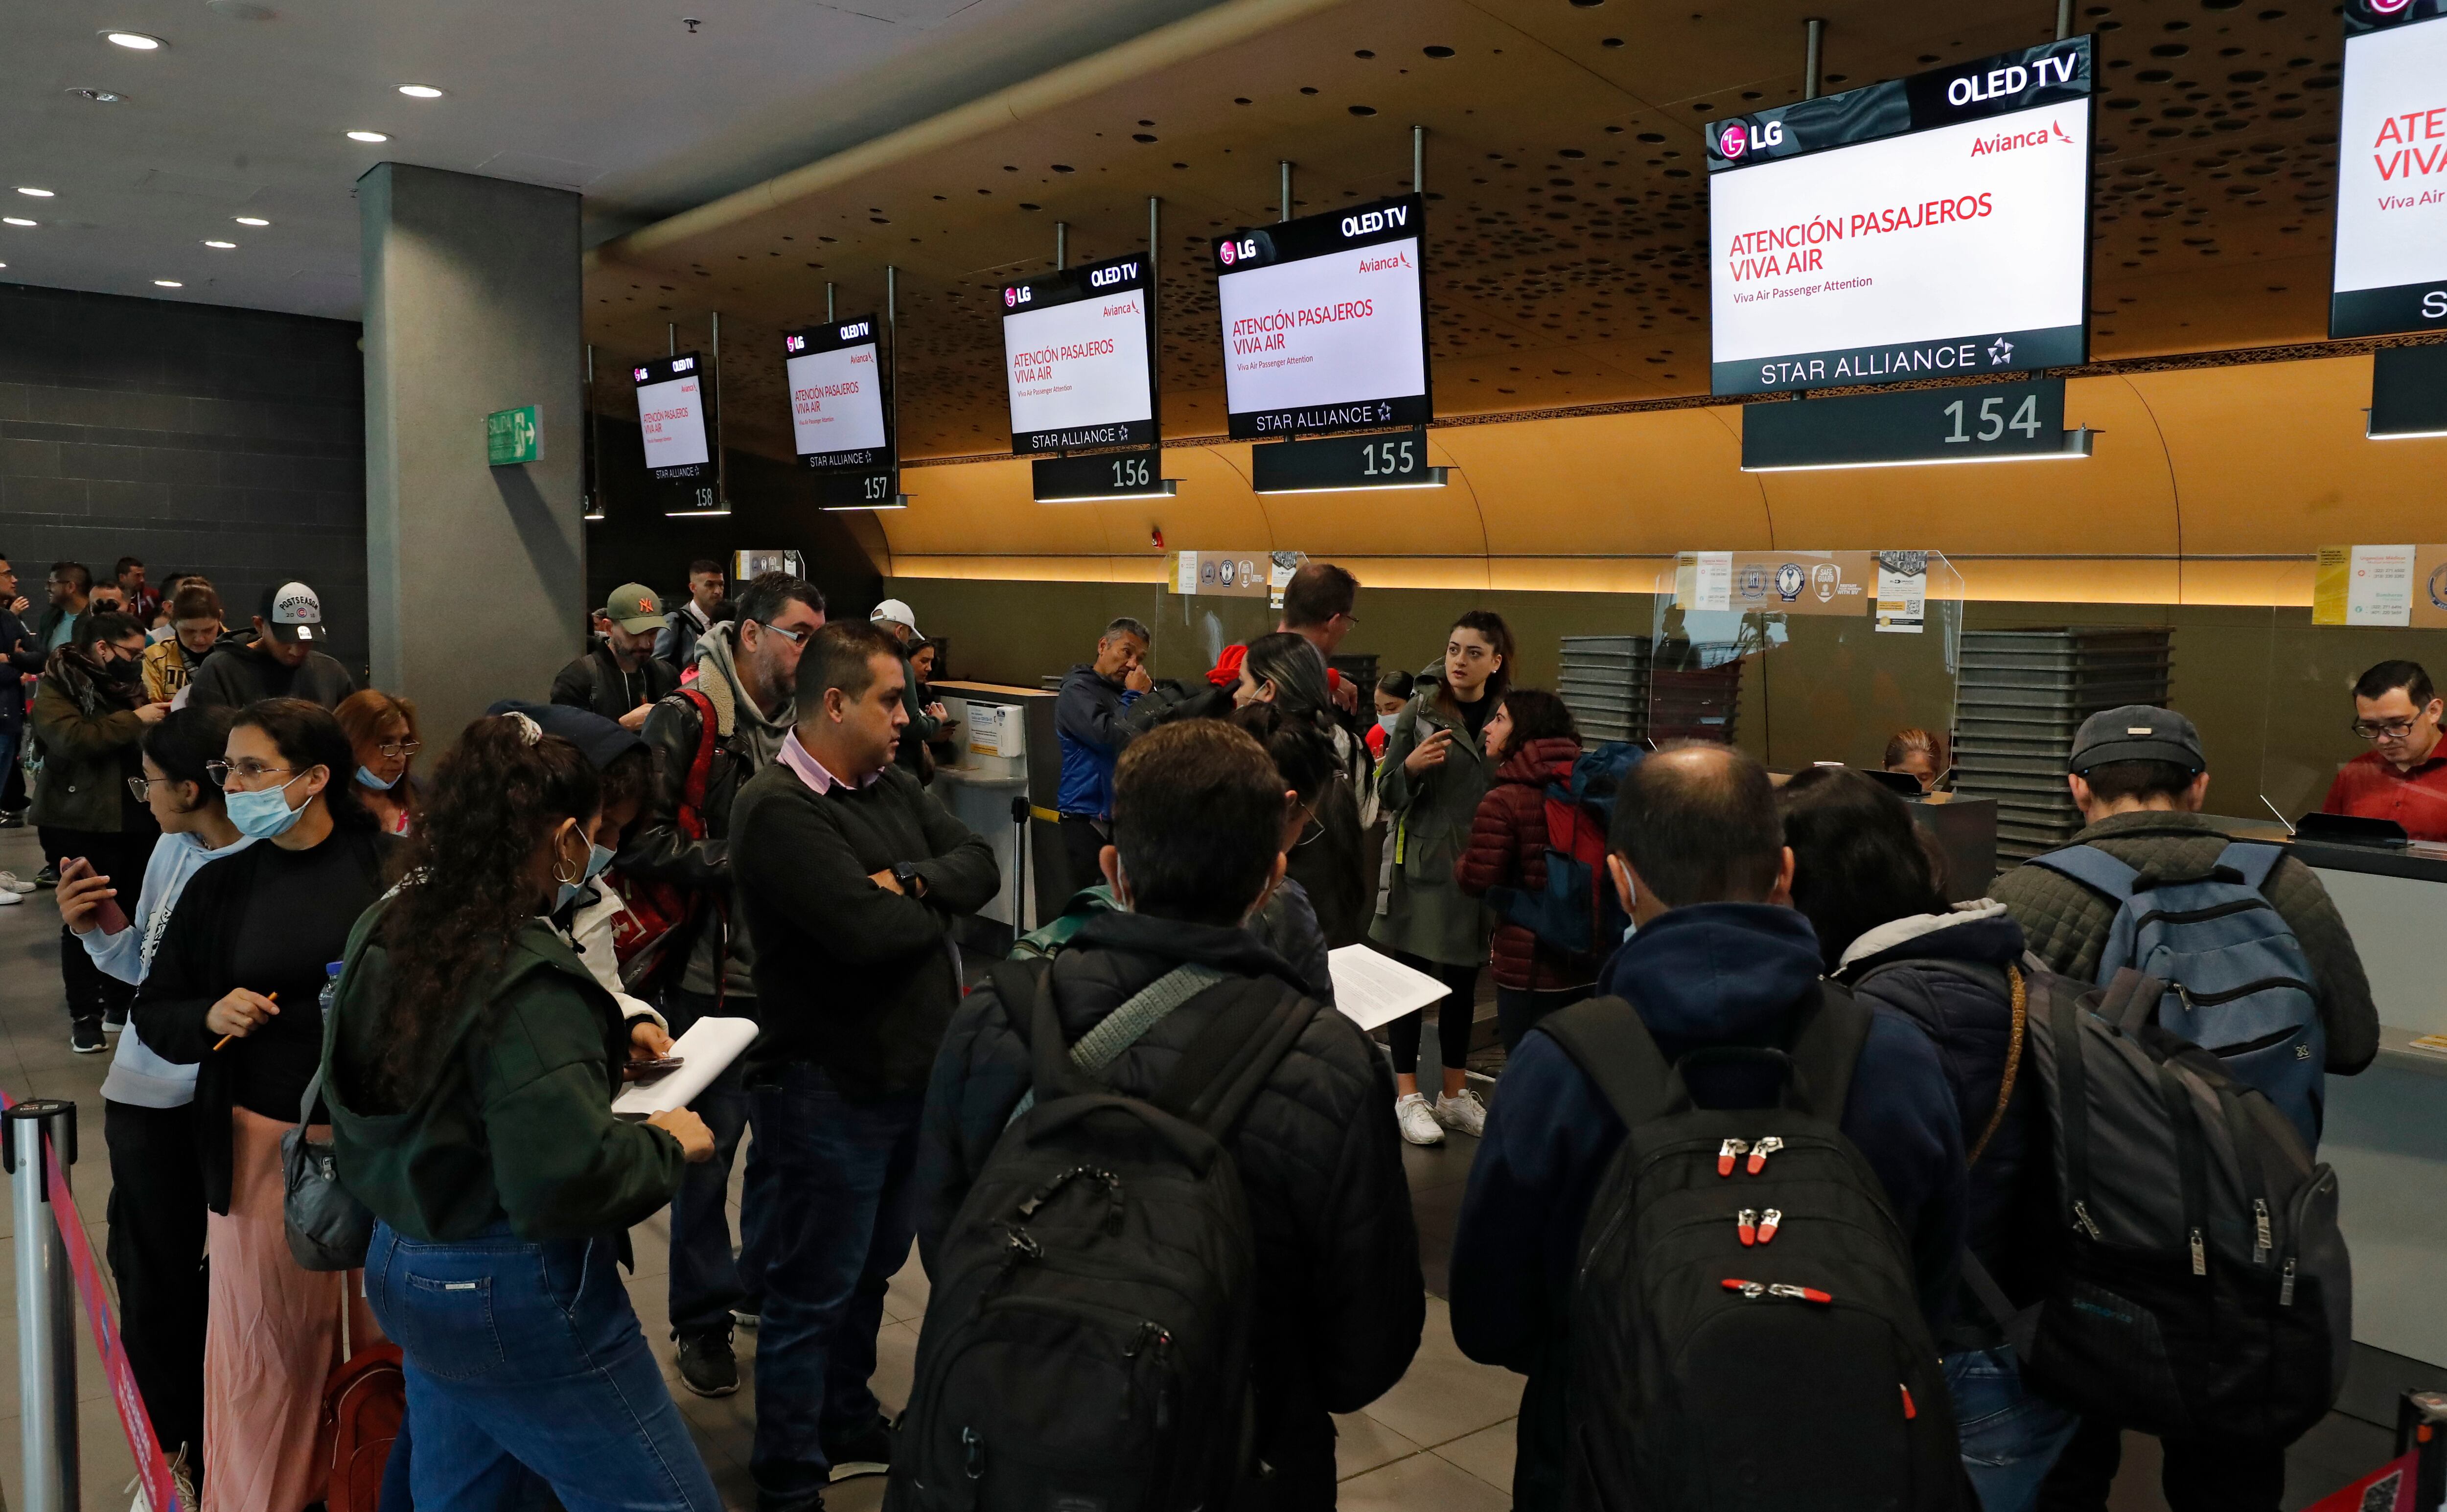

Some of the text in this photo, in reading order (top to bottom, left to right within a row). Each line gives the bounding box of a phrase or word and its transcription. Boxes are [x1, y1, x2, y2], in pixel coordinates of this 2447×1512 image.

[1948, 53, 2076, 106] OLED TV
[1752, 121, 1782, 150] LG
[1971, 128, 2048, 158] Avianca
[2378, 190, 2445, 210] Viva Air
[1341, 206, 1407, 237] OLED TV
[1730, 193, 1992, 257] ATENCIÓN PASAJEROS
[1236, 239, 1256, 260] LG
[1091, 262, 1137, 288] OLED TV
[1359, 256, 1399, 274] Avianca
[1730, 249, 1824, 283] VIVA AIR
[1016, 286, 1032, 304] LG
[1733, 275, 1873, 304] Viva Air Passenger Attention
[1103, 304, 1131, 318] Avianca
[1232, 298, 1373, 337] ATENCIÓN PASAJEROS
[840, 321, 869, 340] OLED TV
[794, 336, 805, 350] LG
[1014, 338, 1114, 368] ATENCIÓN PASAJEROS
[1233, 333, 1285, 355] VIVA AIR
[672, 357, 693, 372] OLED TV
[851, 354, 868, 365] Avianca
[1237, 354, 1314, 371] Viva Air Passenger Attention
[1762, 344, 1976, 385] STAR ALLIANCE
[640, 367, 648, 380] LG
[1014, 366, 1053, 384] VIVA AIR
[795, 381, 859, 403] ATENCIÓN PASAJEROS
[1033, 386, 1053, 398] Passenger
[1053, 383, 1072, 394] Attention
[643, 407, 689, 423] ATENCIÓN PASAJEROS
[796, 400, 821, 414] VIVA AIR
[644, 423, 663, 435] VIVA AIR
[1256, 406, 1372, 432] STAR ALLIANCE
[1943, 394, 2042, 443] 154
[1032, 427, 1115, 449] STAR ALLIANCE
[810, 453, 864, 467] STAR ALLIANCE
[1362, 441, 1414, 475] 155
[656, 467, 694, 480] STAR ALLIANCE
[1112, 458, 1150, 487] 156
[695, 487, 713, 507] 158
[864, 477, 887, 499] 157
[279, 596, 319, 611] POSTSEASON
